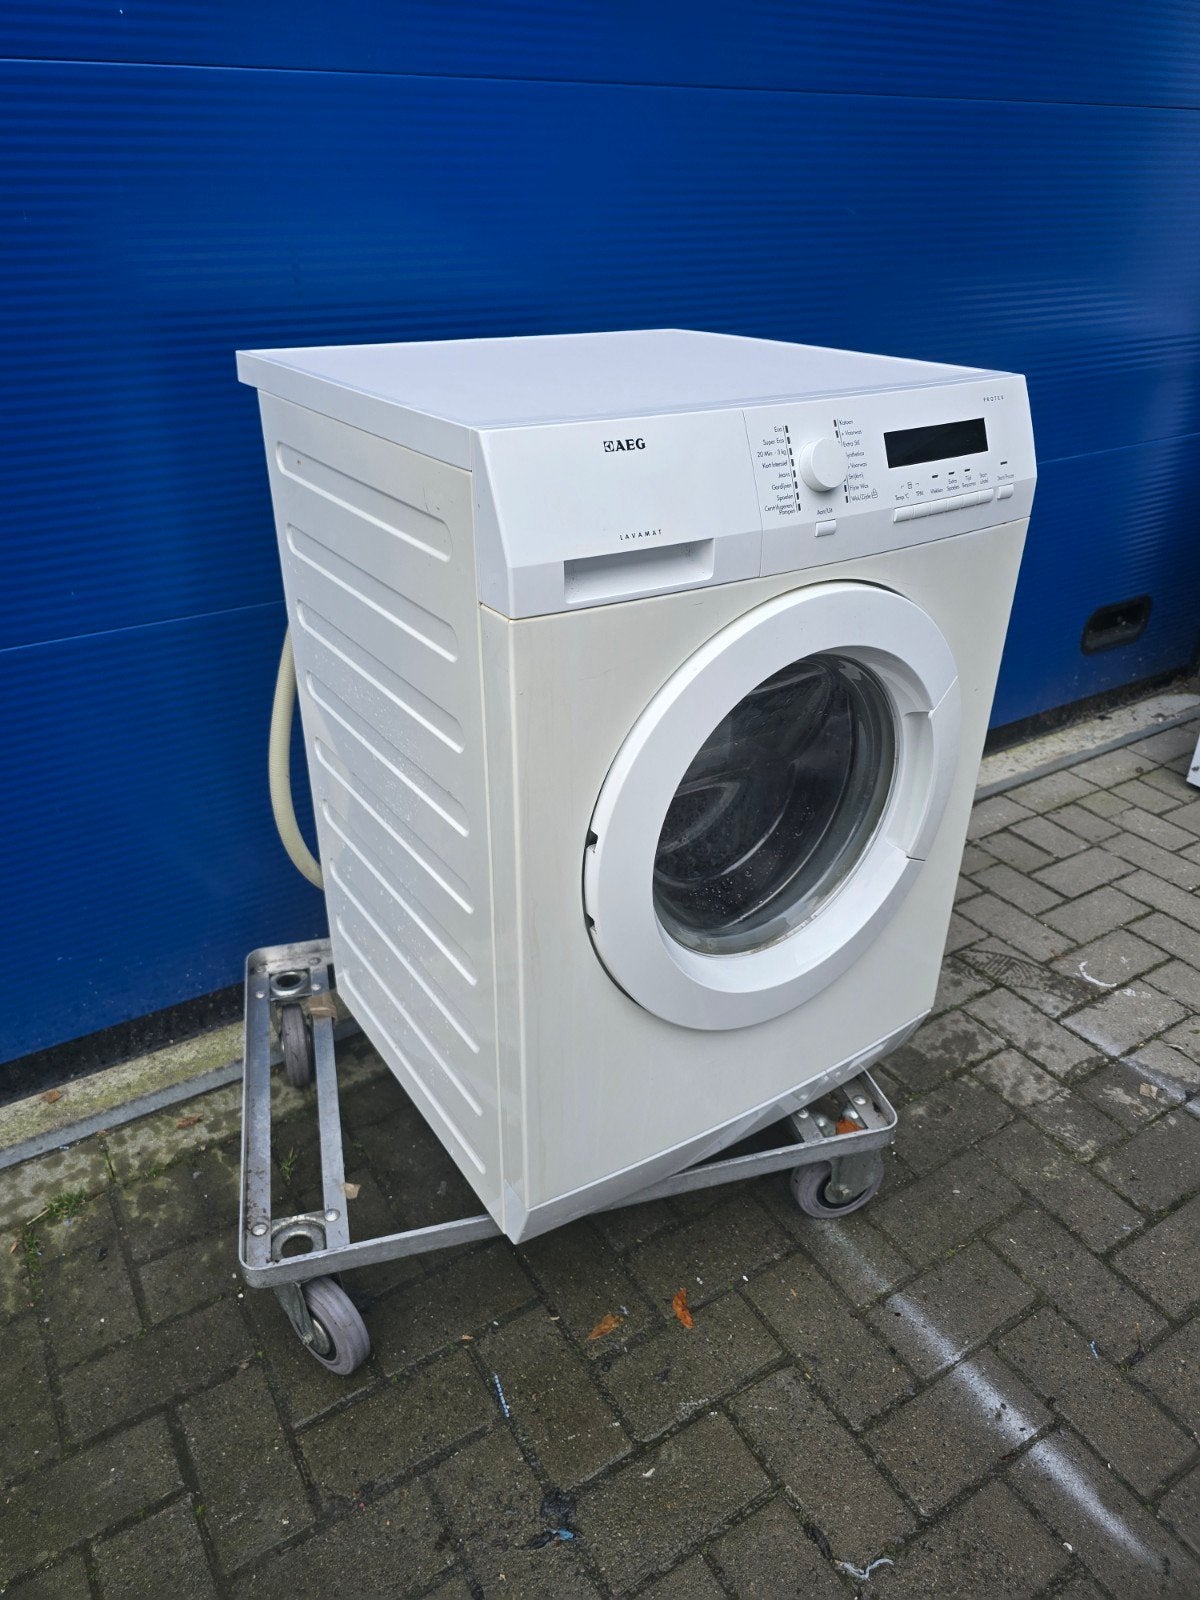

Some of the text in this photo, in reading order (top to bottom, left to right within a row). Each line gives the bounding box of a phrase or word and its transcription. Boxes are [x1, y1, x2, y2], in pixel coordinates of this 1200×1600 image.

[616, 438, 646, 451] AEG
[846, 451, 865, 459] ynthetica
[619, 529, 662, 540] LAVAMAT
